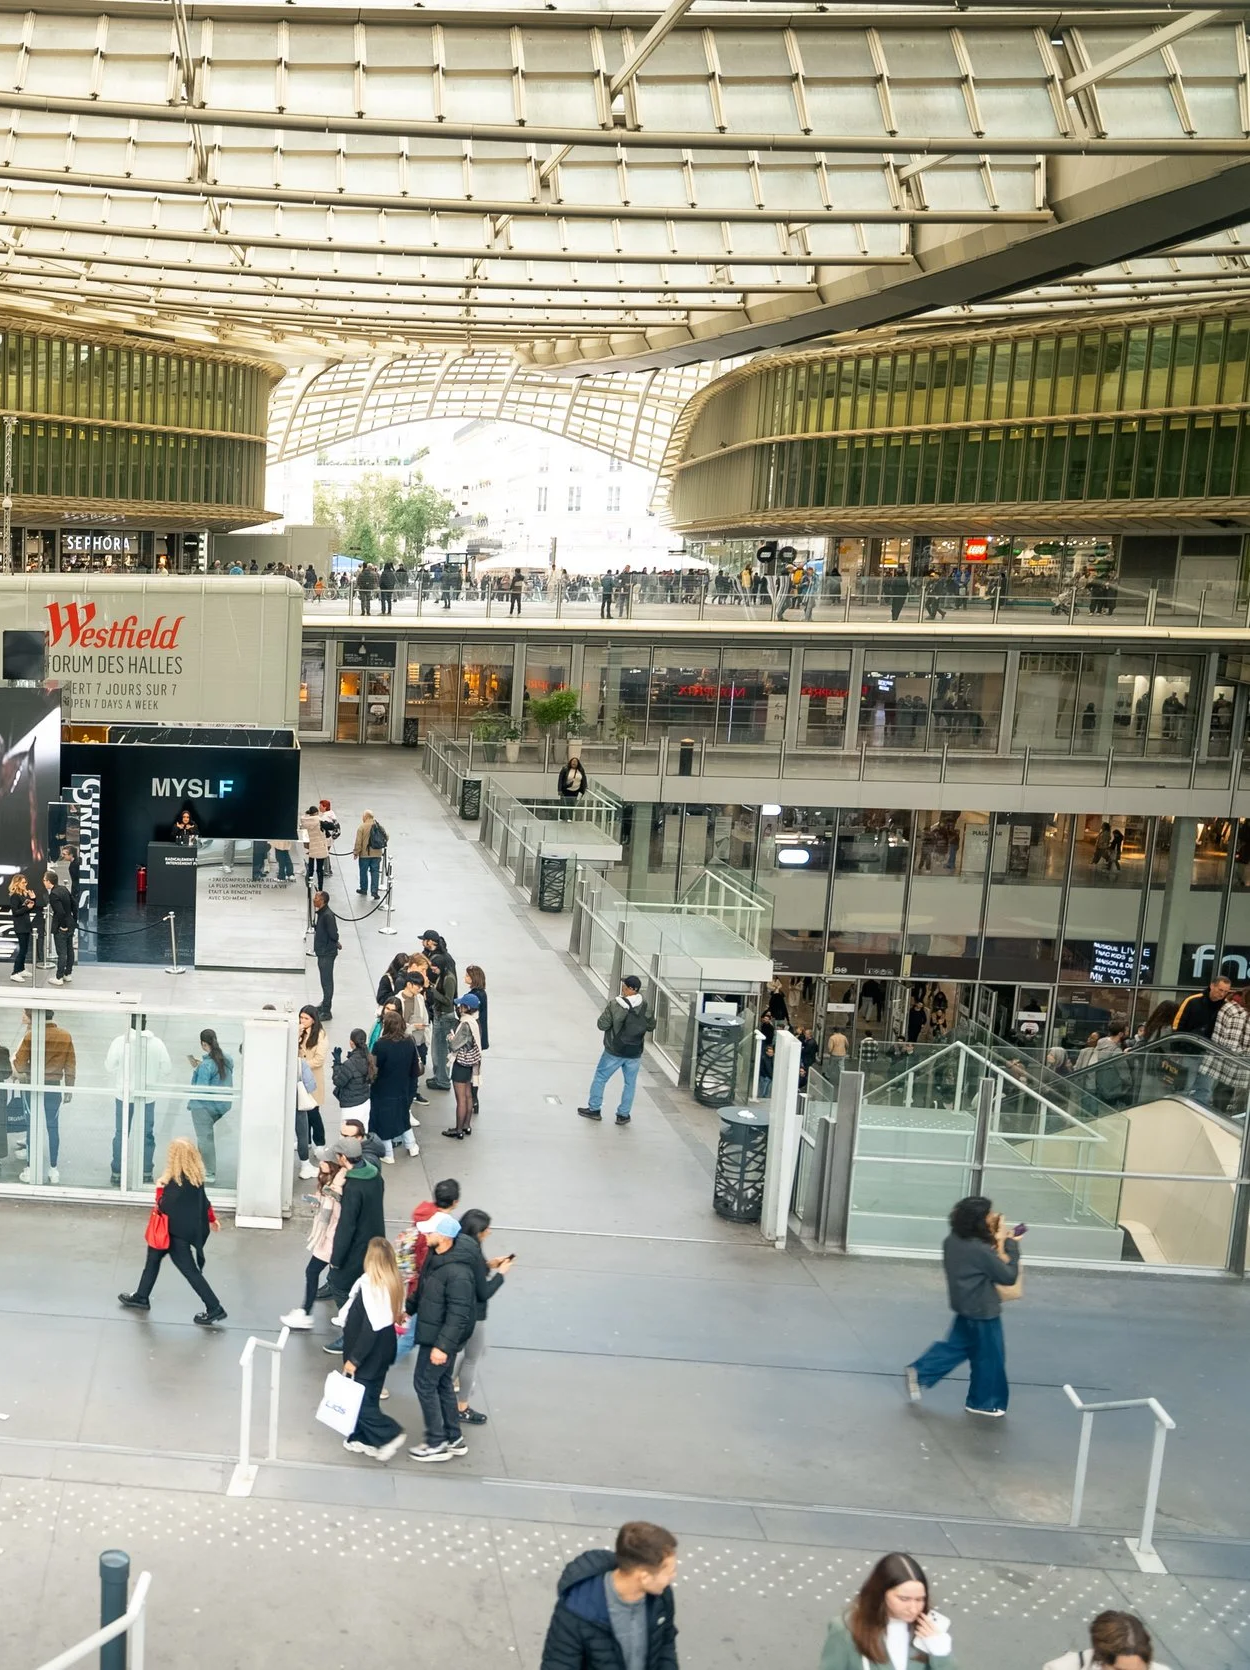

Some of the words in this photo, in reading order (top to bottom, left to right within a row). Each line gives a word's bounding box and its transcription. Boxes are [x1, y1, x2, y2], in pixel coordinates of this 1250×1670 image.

[67, 536, 130, 550] SEPHORA
[967, 545, 988, 555] LEGO
[44, 602, 186, 650] Westfield
[97, 656, 124, 675] DES
[128, 656, 183, 676] HALLES
[96, 683, 101, 695] 7
[105, 684, 142, 696] JOURS
[146, 684, 167, 696] SUR
[172, 684, 178, 696] 7
[94, 699, 99, 709] 7
[101, 699, 123, 710] DAYS
[126, 700, 132, 710] A
[135, 700, 159, 711] WEEK
[152, 778, 234, 799] MYSLF
[1192, 944, 1250, 980] fn
